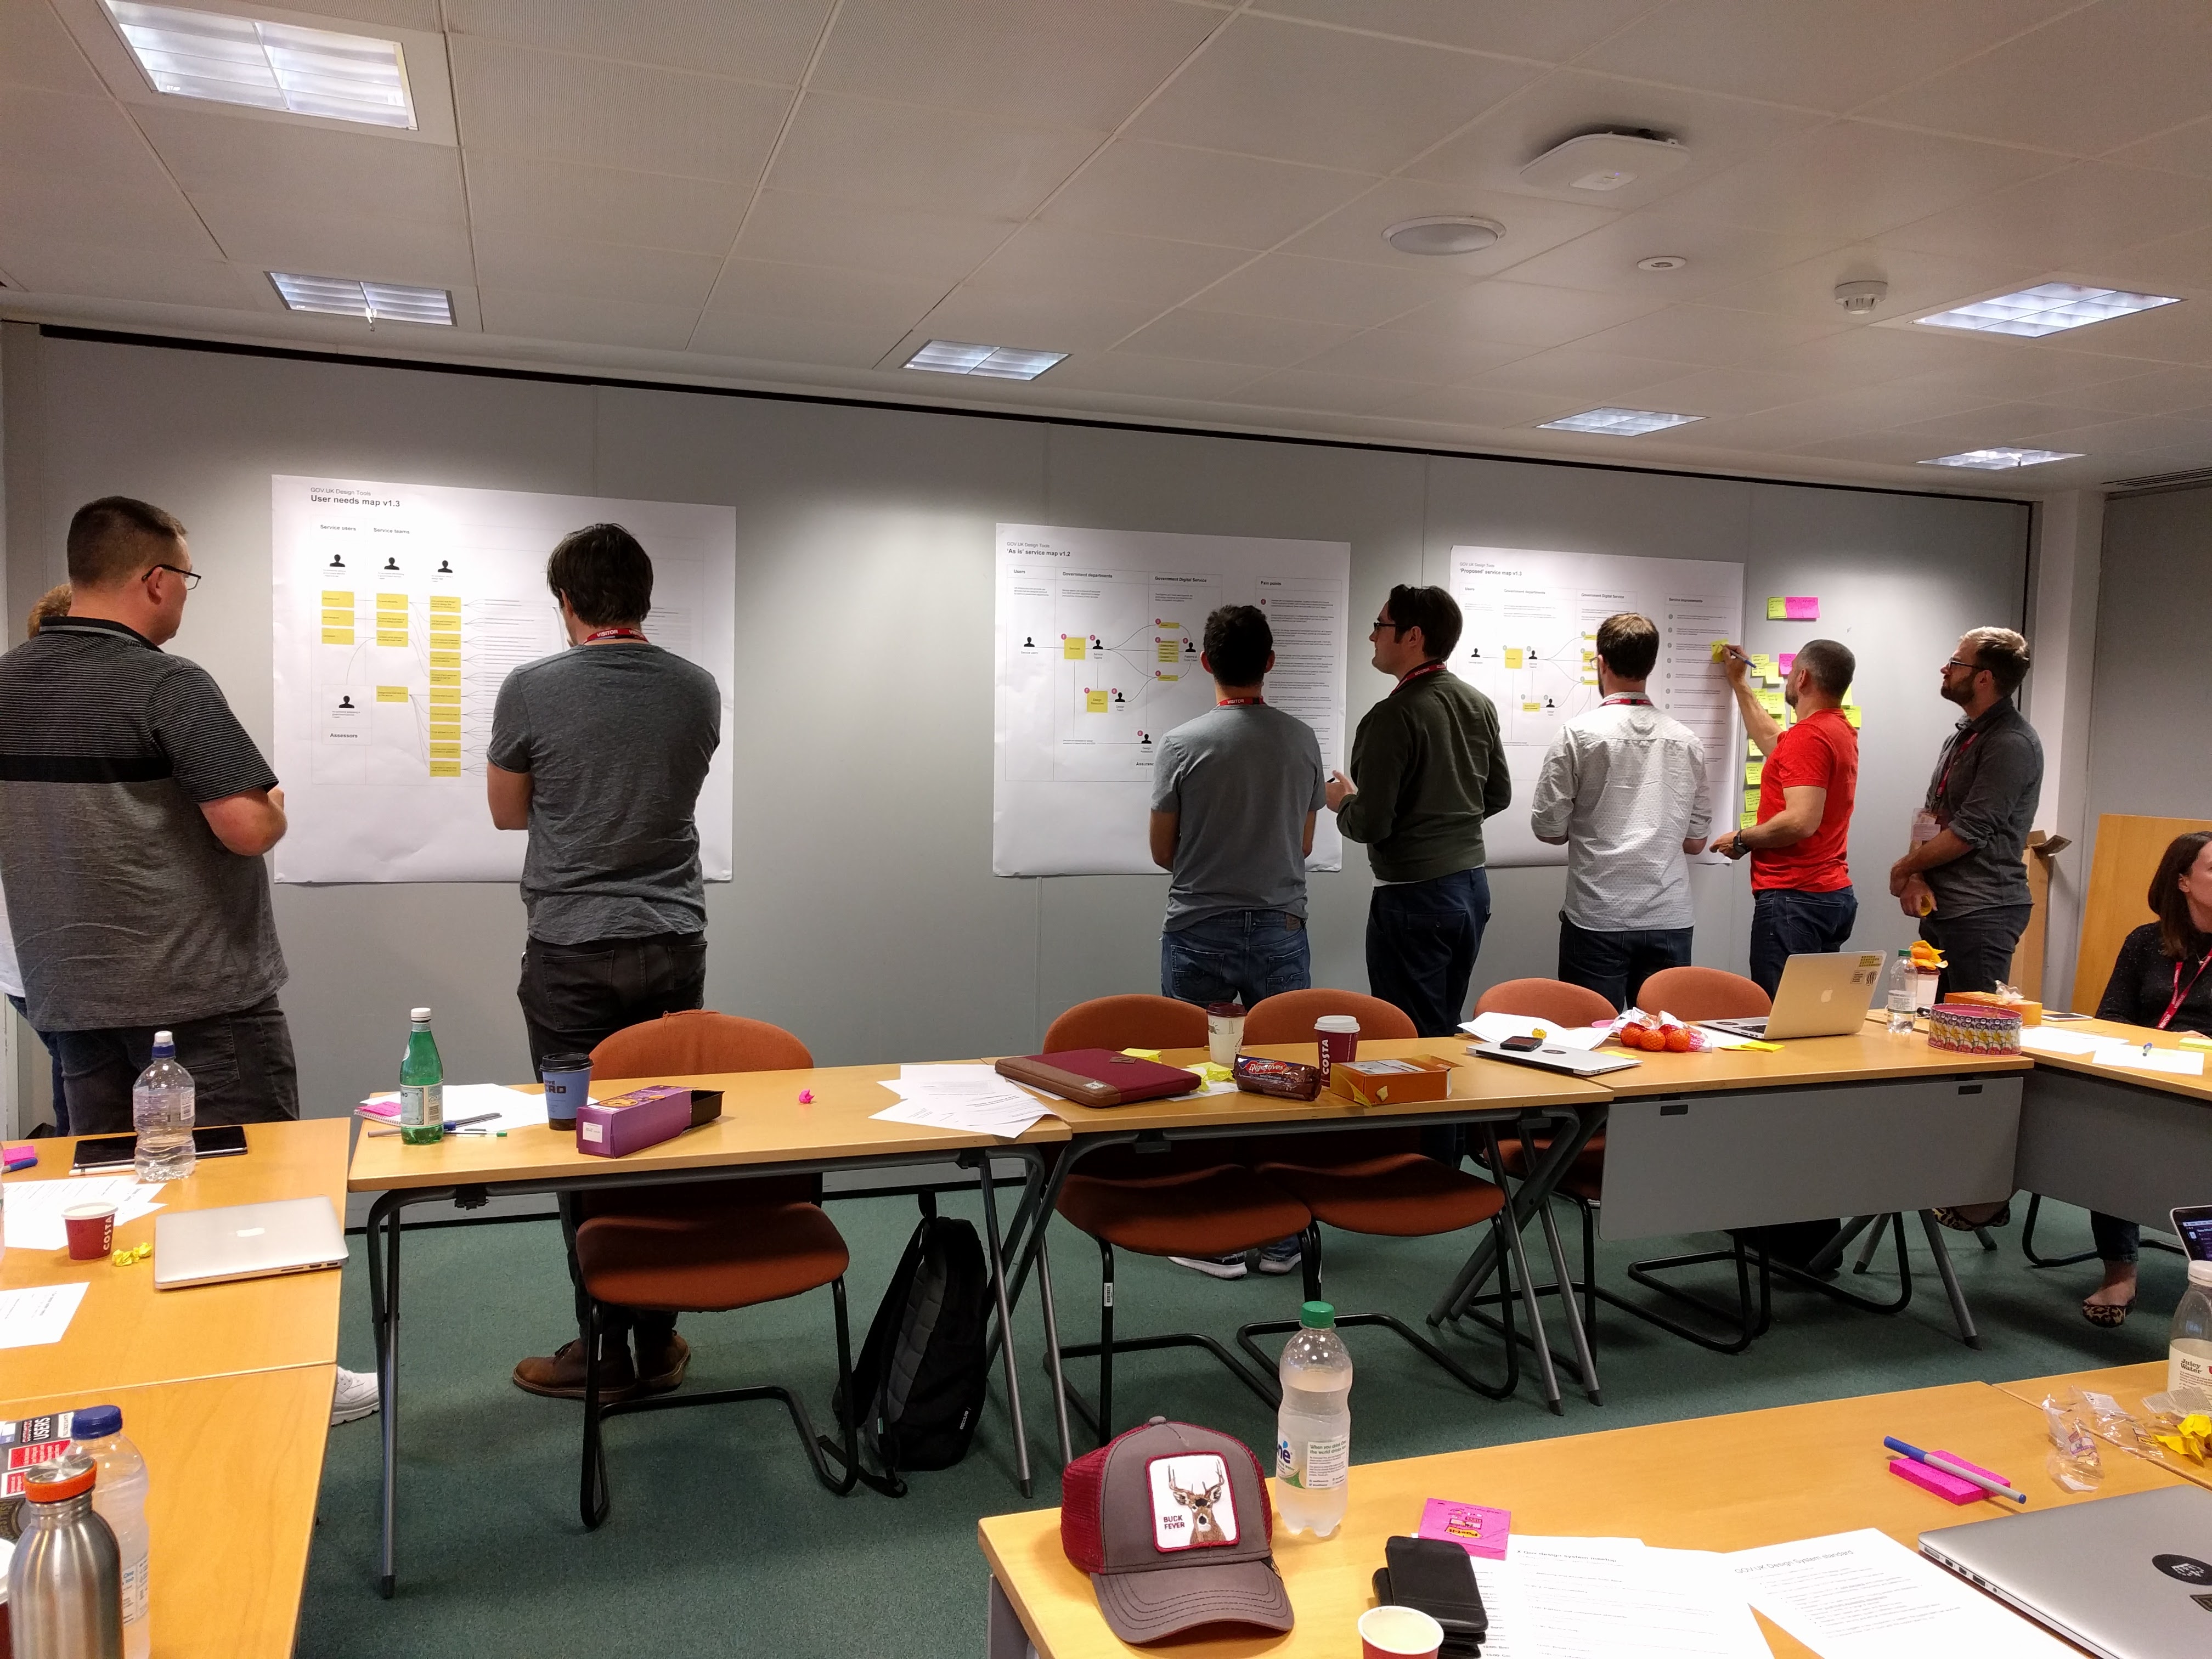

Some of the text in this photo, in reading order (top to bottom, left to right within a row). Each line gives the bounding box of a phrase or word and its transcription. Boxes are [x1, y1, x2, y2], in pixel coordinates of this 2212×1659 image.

[1322, 1039, 1330, 1075] COSTA
[1249, 1063, 1283, 1072] Digestives
[103, 1216, 112, 1250] COSTA
[2180, 1362, 2203, 1374] Water
[2181, 1358, 2201, 1369] Juicy
[33, 1417, 50, 1440] USERS
[1449, 1528, 1478, 1537] Post-it
[1767, 1560, 1793, 1568] Design
[1793, 1555, 1821, 1564] System
[1822, 1550, 1854, 1559] standard
